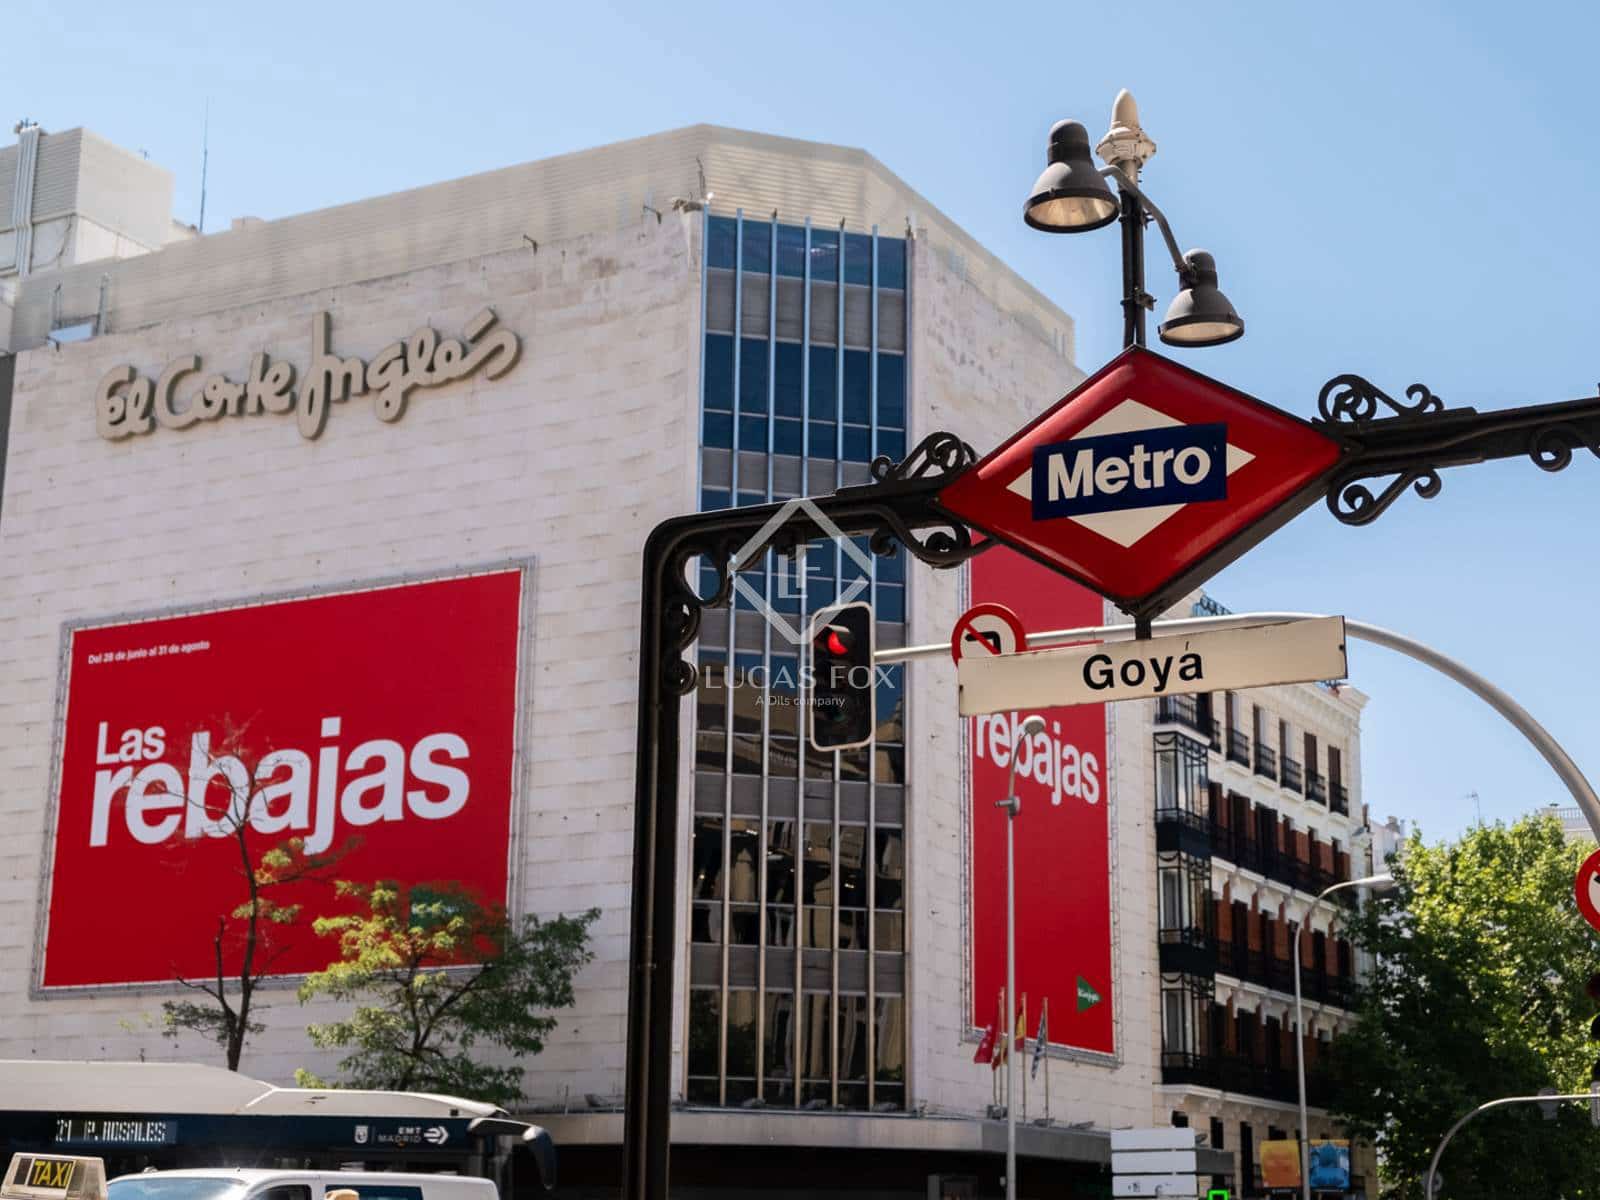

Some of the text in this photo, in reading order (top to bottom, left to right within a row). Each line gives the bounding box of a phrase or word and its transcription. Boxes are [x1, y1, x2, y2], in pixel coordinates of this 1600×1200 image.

[96, 365, 155, 441] El
[153, 351, 296, 431] Corte
[1047, 445, 1212, 503] Metro
[115, 650, 126, 661] de
[168, 644, 180, 655] de
[96, 721, 165, 764] Las
[976, 711, 1100, 806] rebajas
[89, 716, 471, 856] rebajas
[32, 1160, 73, 1186] TAXI
